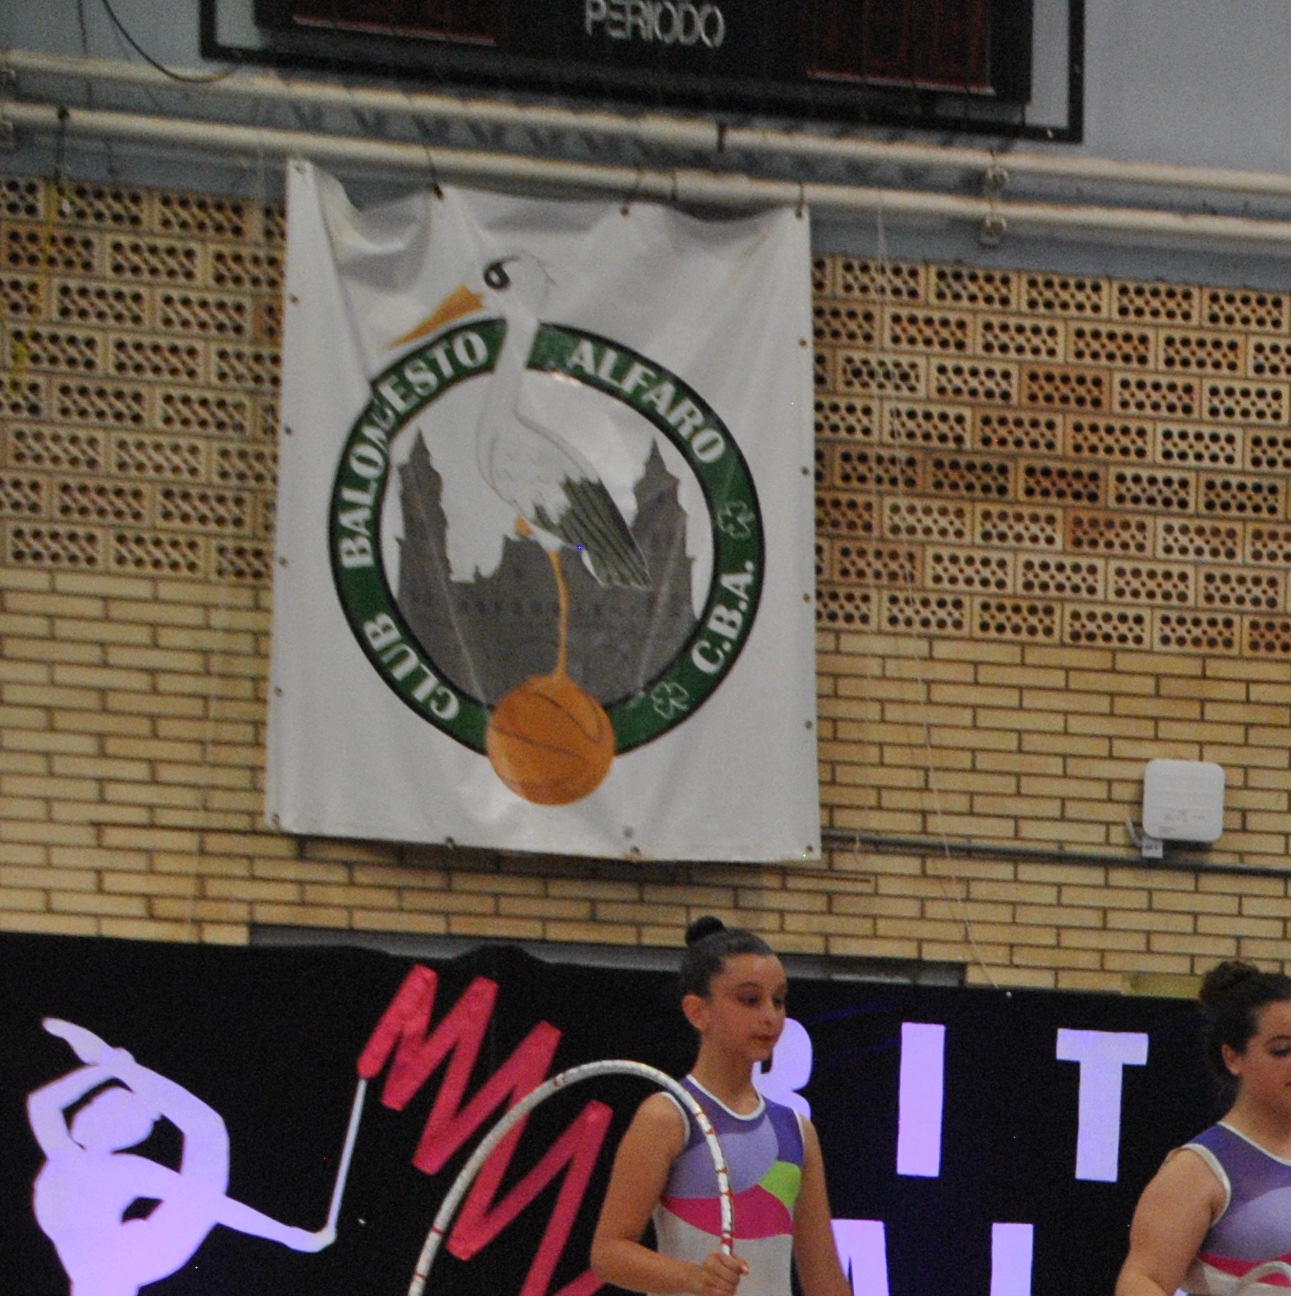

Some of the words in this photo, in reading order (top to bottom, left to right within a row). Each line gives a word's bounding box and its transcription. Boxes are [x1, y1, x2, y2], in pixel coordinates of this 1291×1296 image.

[585, 0, 725, 48] PERIODO
[362, 612, 460, 720] CLUB
[566, 339, 726, 464] ALFARO
[691, 560, 756, 674] C.B.A.
